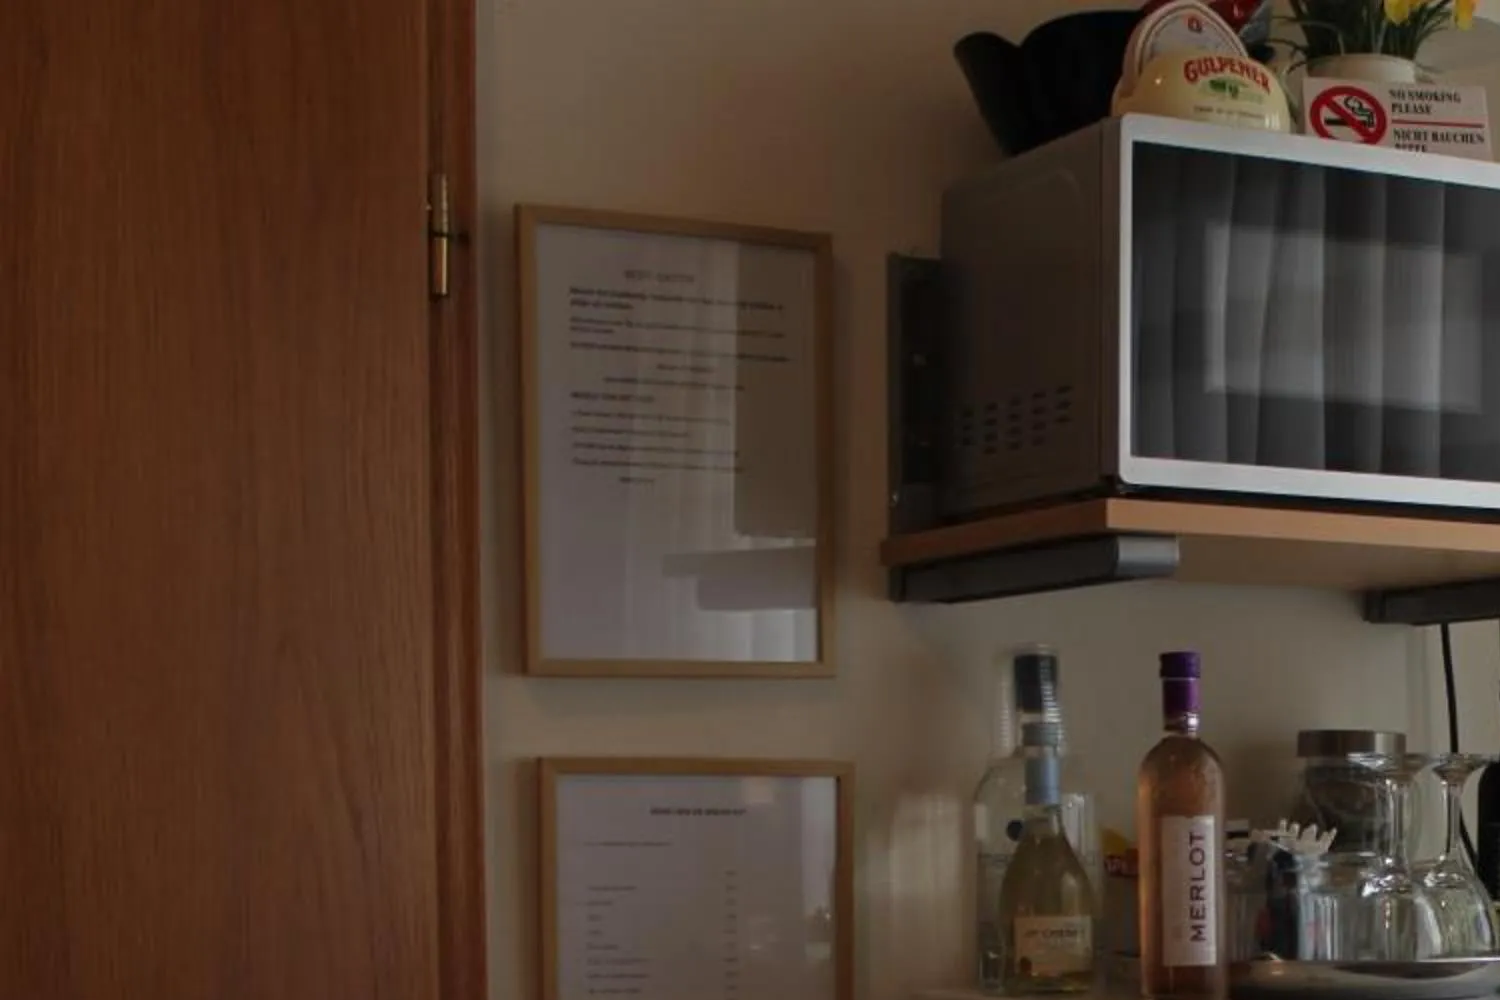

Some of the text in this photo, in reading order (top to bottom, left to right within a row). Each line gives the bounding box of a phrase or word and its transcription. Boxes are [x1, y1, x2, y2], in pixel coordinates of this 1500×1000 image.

[1389, 89, 1461, 103] NO SMOKING
[1391, 103, 1432, 114] PLEASE
[1393, 129, 1485, 144] NICHT RAUCHEN
[1189, 832, 1206, 941] MERLOT
